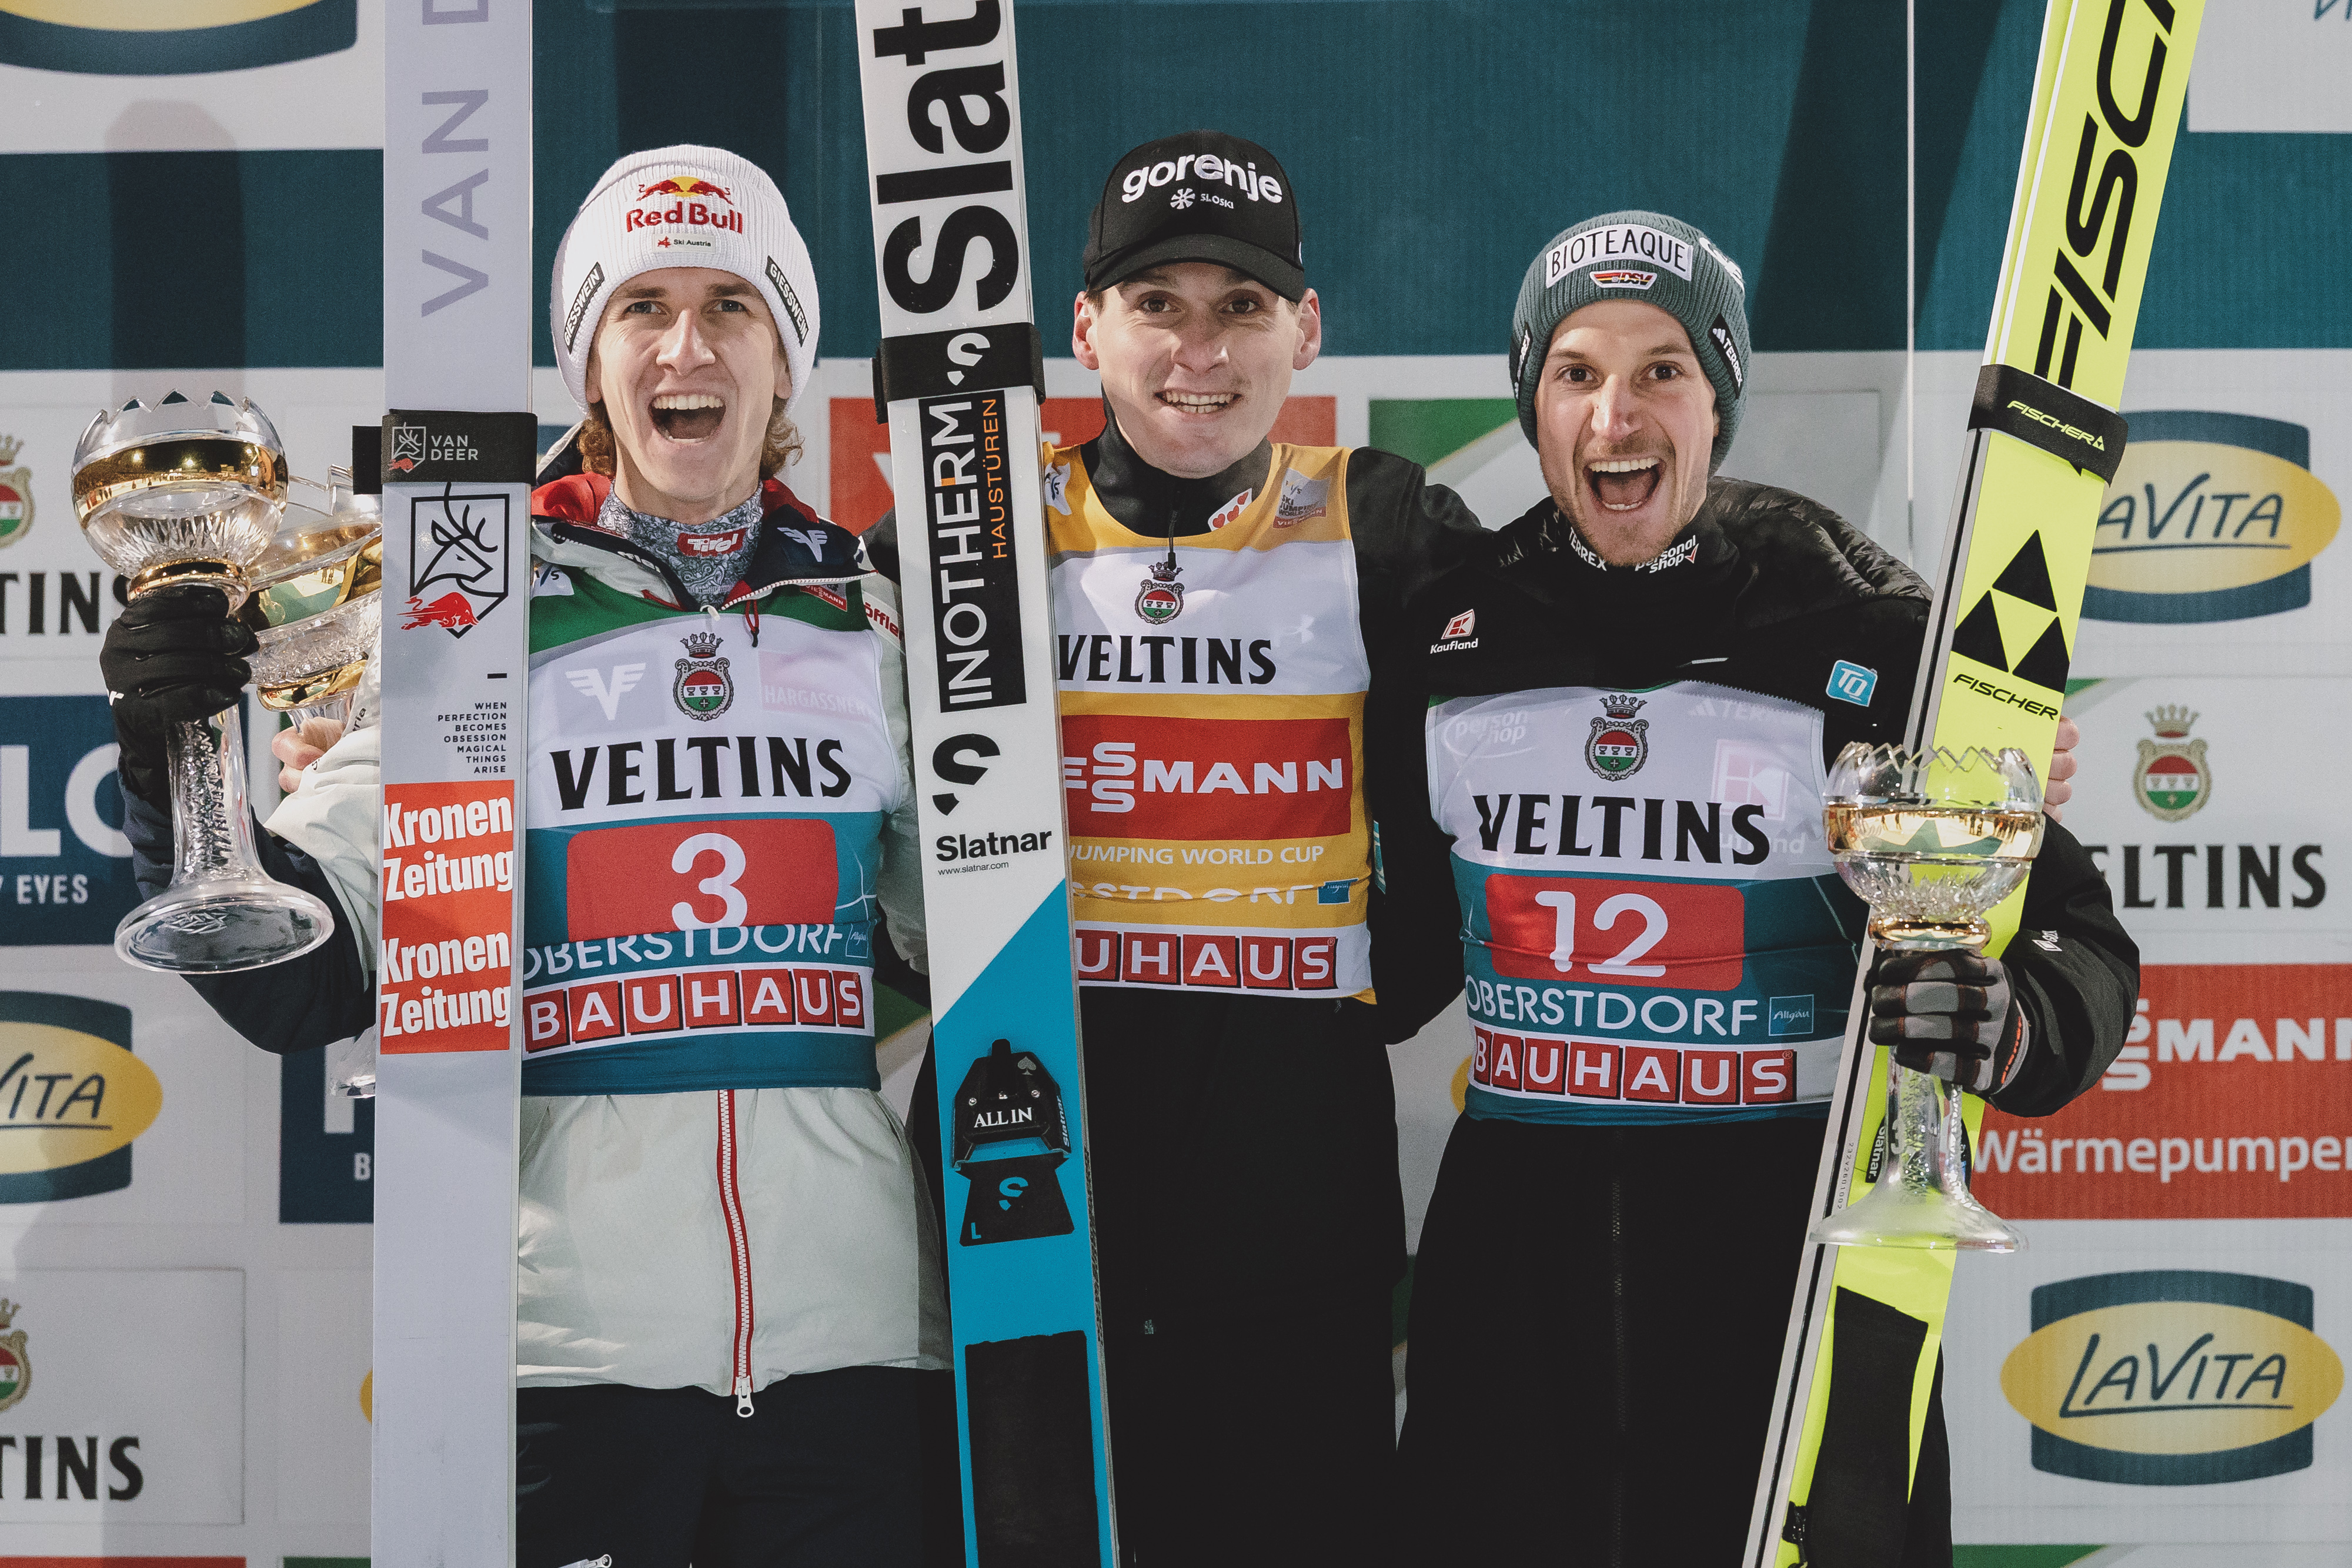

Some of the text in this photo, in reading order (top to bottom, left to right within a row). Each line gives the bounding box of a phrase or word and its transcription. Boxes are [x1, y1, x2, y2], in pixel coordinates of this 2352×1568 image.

[873, 0, 1018, 314] Slat
[1122, 154, 1282, 203] gorenje
[422, 89, 489, 317] VAN
[626, 202, 743, 235] Red Bull
[1200, 193, 1234, 209] SLOSKI
[2033, 0, 2176, 390] FISC
[1551, 229, 1686, 278] BIOTEAQUE
[564, 268, 602, 346] GIESSWEIN
[769, 263, 808, 339] GIESSWEIN
[1722, 337, 1743, 388] TERREX
[431, 435, 469, 447] VAN
[2006, 400, 2095, 445] FISCHER
[430, 449, 479, 460] DEER
[982, 399, 1007, 559] HAUSTÜREN
[687, 533, 739, 552] Tirol
[928, 401, 993, 704] INOTHERM
[1569, 527, 1607, 571] TERREX
[1649, 553, 1685, 574] shop
[1058, 634, 1277, 685] VELTINS
[1430, 638, 1478, 654] Kaufland
[437, 713, 507, 722] PERFECTION
[1953, 673, 2059, 720] FISCHER
[444, 734, 506, 743] OBSESSION
[455, 723, 507, 732] BECOMES
[457, 744, 506, 753] MAGICAL
[466, 755, 506, 763] THINGS
[474, 765, 506, 774] ARISE
[550, 736, 852, 811] VELTINS
[383, 797, 513, 850] Kronen
[936, 830, 1052, 862] Slatnar
[1472, 793, 1770, 866] VELTINS
[383, 850, 513, 902] Zeitung
[938, 861, 1009, 876] www.slatnar.com
[1070, 845, 1324, 865] JUMPING WORLD CUP
[17, 875, 88, 904] EYES
[671, 833, 747, 931] 3
[1535, 890, 1668, 977] 12
[381, 932, 510, 985] Kronen
[380, 986, 511, 1038] Zeitung
[532, 977, 861, 1041] BAUHAUS
[1465, 975, 1758, 1037] OBERSTDORF
[1475, 1034, 1788, 1095] BAUHAUS
[974, 1108, 1033, 1128] ALL IN
[1057, 1095, 1070, 1147] Slatnar
[1974, 1128, 2352, 1182] Wärmepumpe
